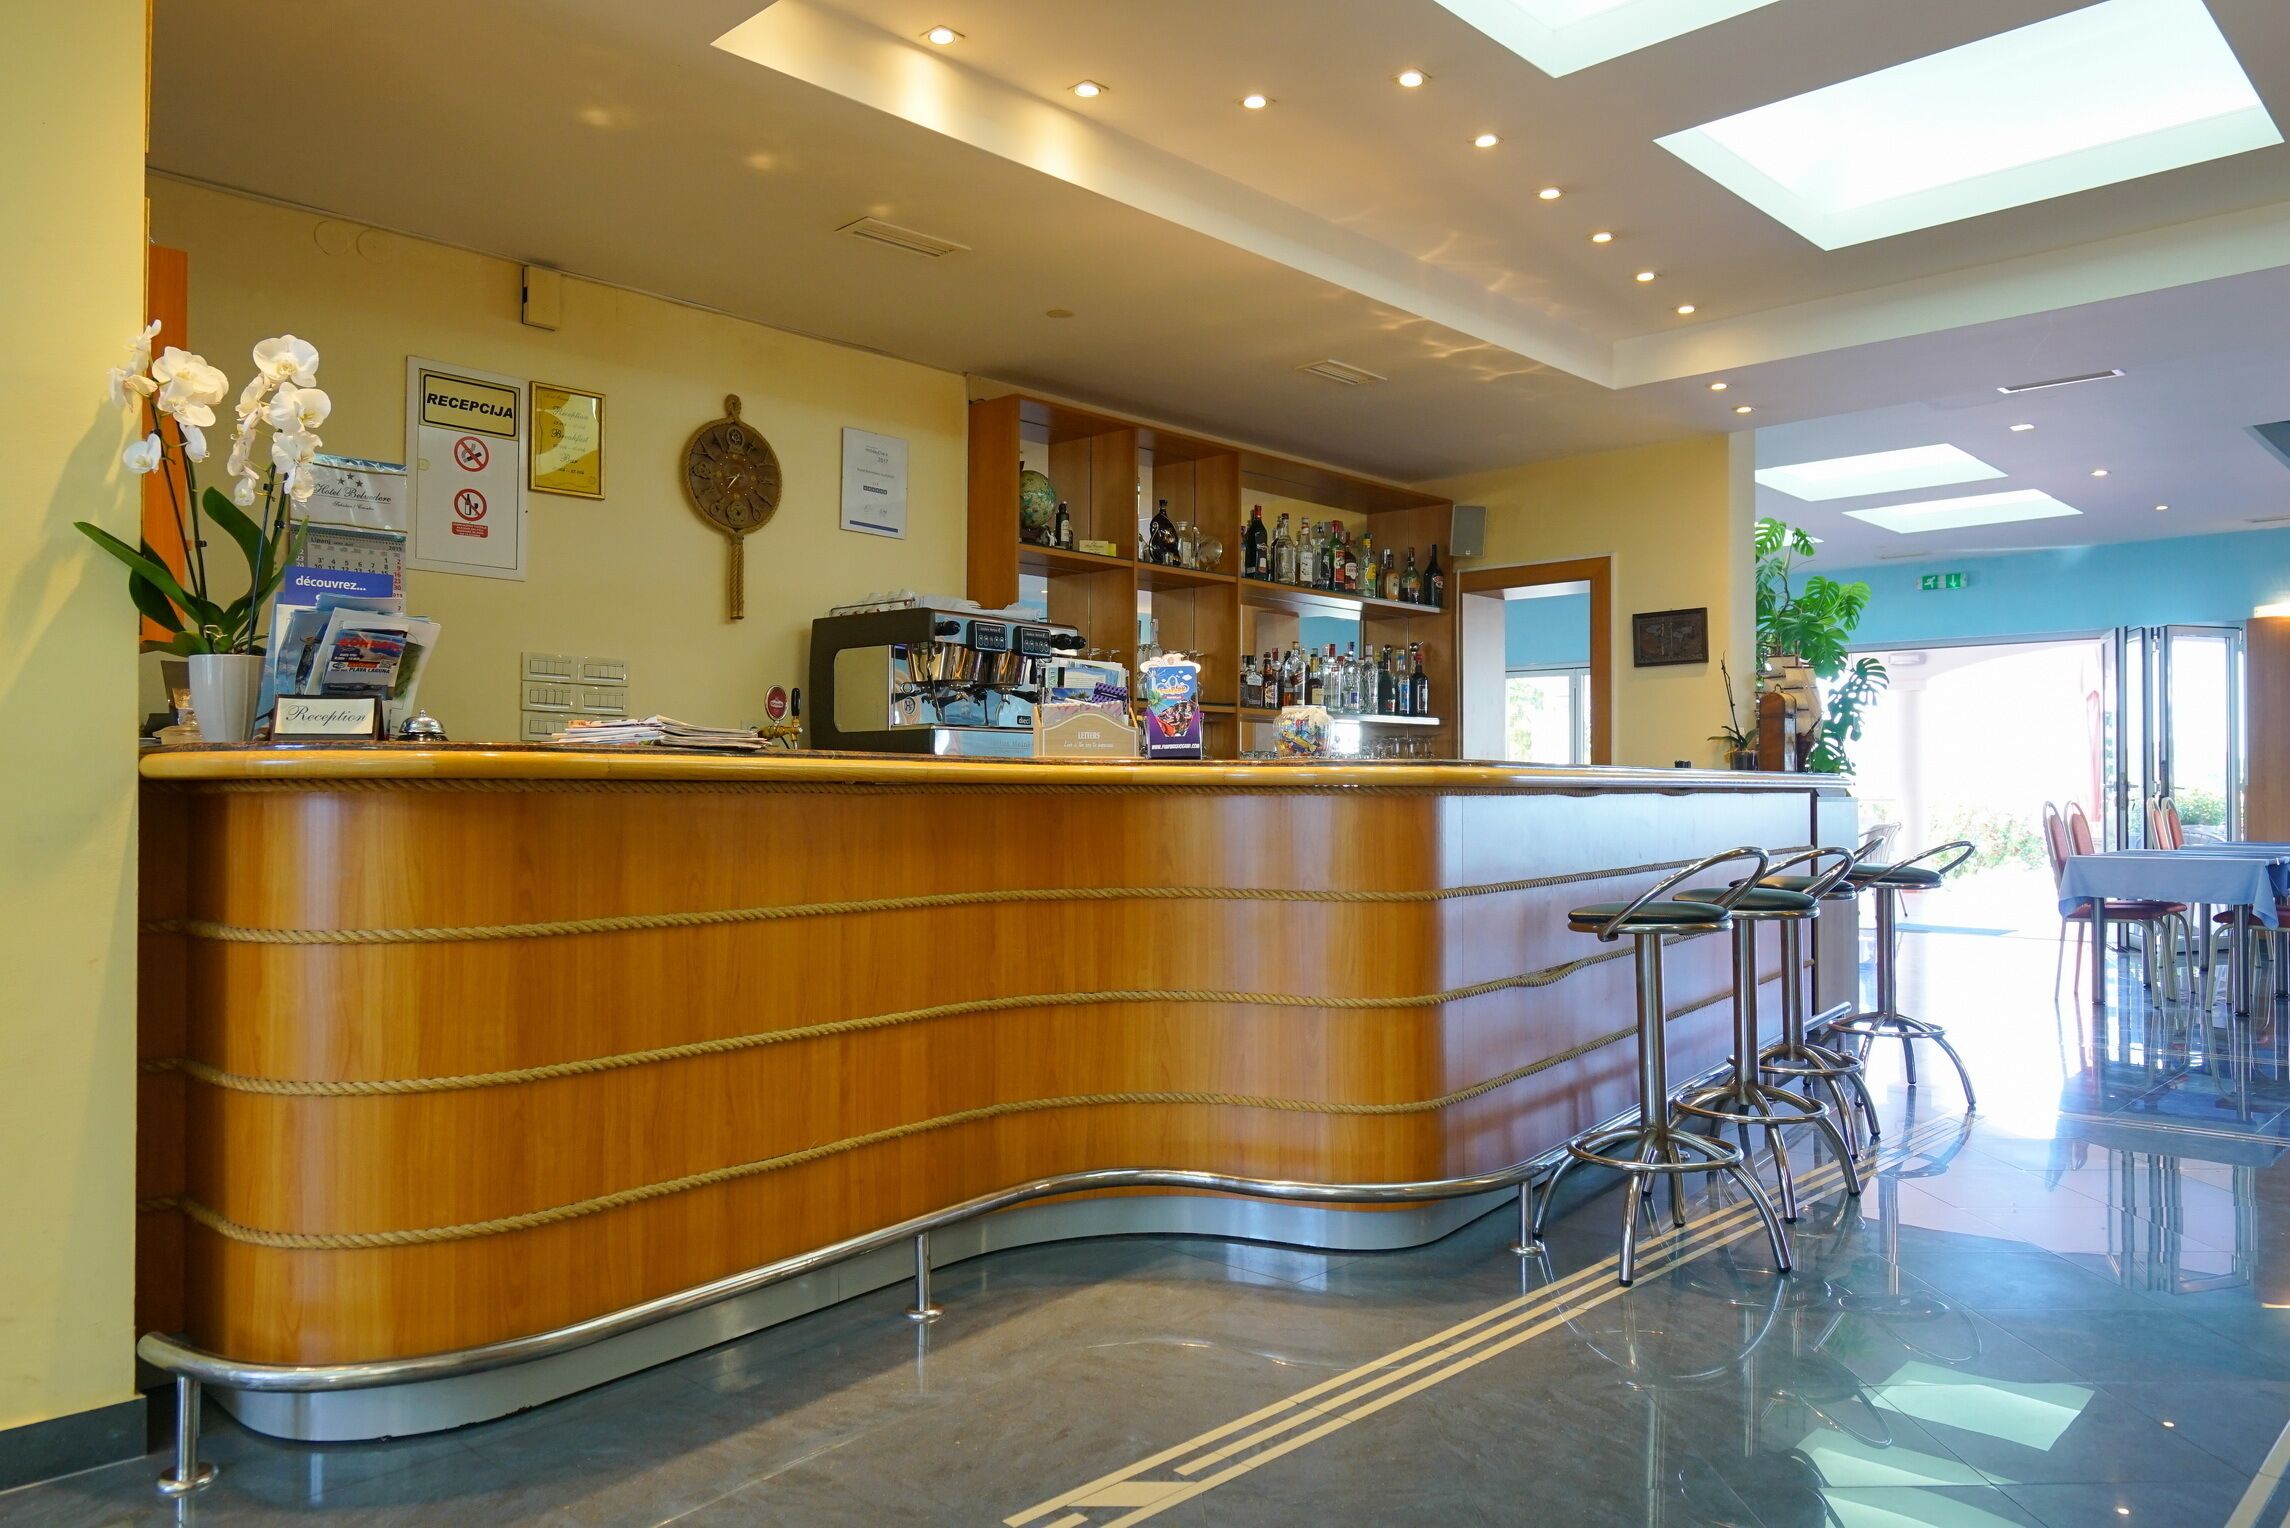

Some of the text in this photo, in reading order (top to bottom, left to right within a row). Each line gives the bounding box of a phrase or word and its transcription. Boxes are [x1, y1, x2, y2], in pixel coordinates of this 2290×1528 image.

[427, 393, 513, 418] RECEPCIJA
[314, 484, 341, 496] Hotel
[296, 575, 367, 591] découvrez...
[286, 704, 366, 727] Reception
[1077, 731, 1100, 740] LETTERS
